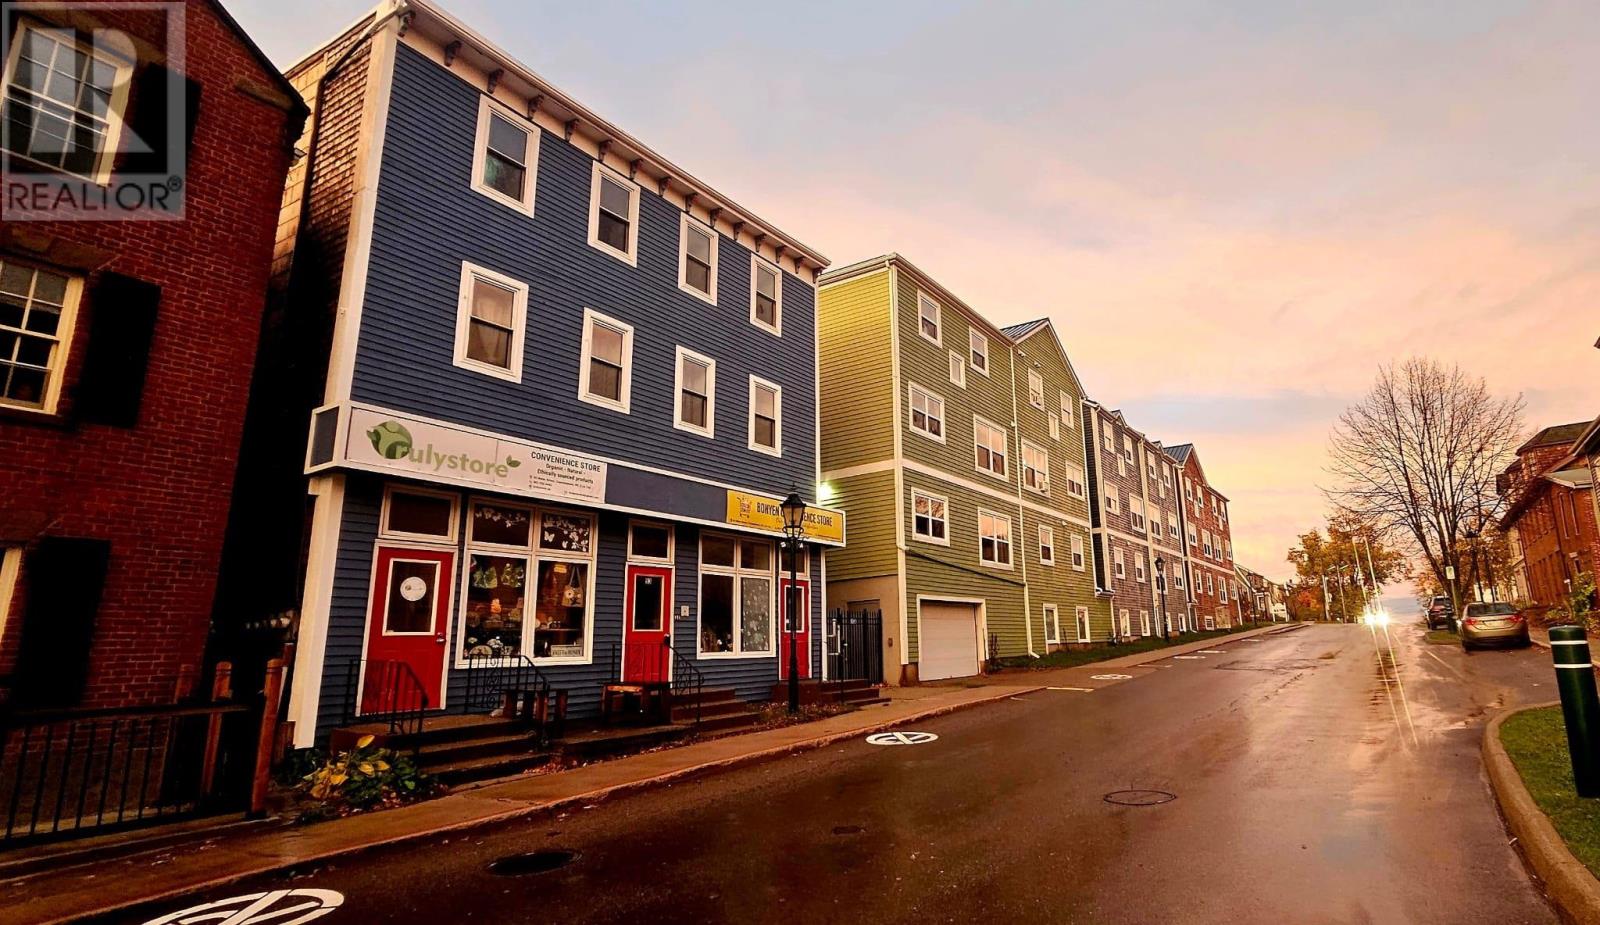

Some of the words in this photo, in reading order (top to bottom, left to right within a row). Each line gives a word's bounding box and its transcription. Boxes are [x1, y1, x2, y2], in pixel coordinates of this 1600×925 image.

[531, 451, 579, 468] CONVENIENCE
[580, 462, 601, 473] STORE
[816, 514, 833, 527] STORE
